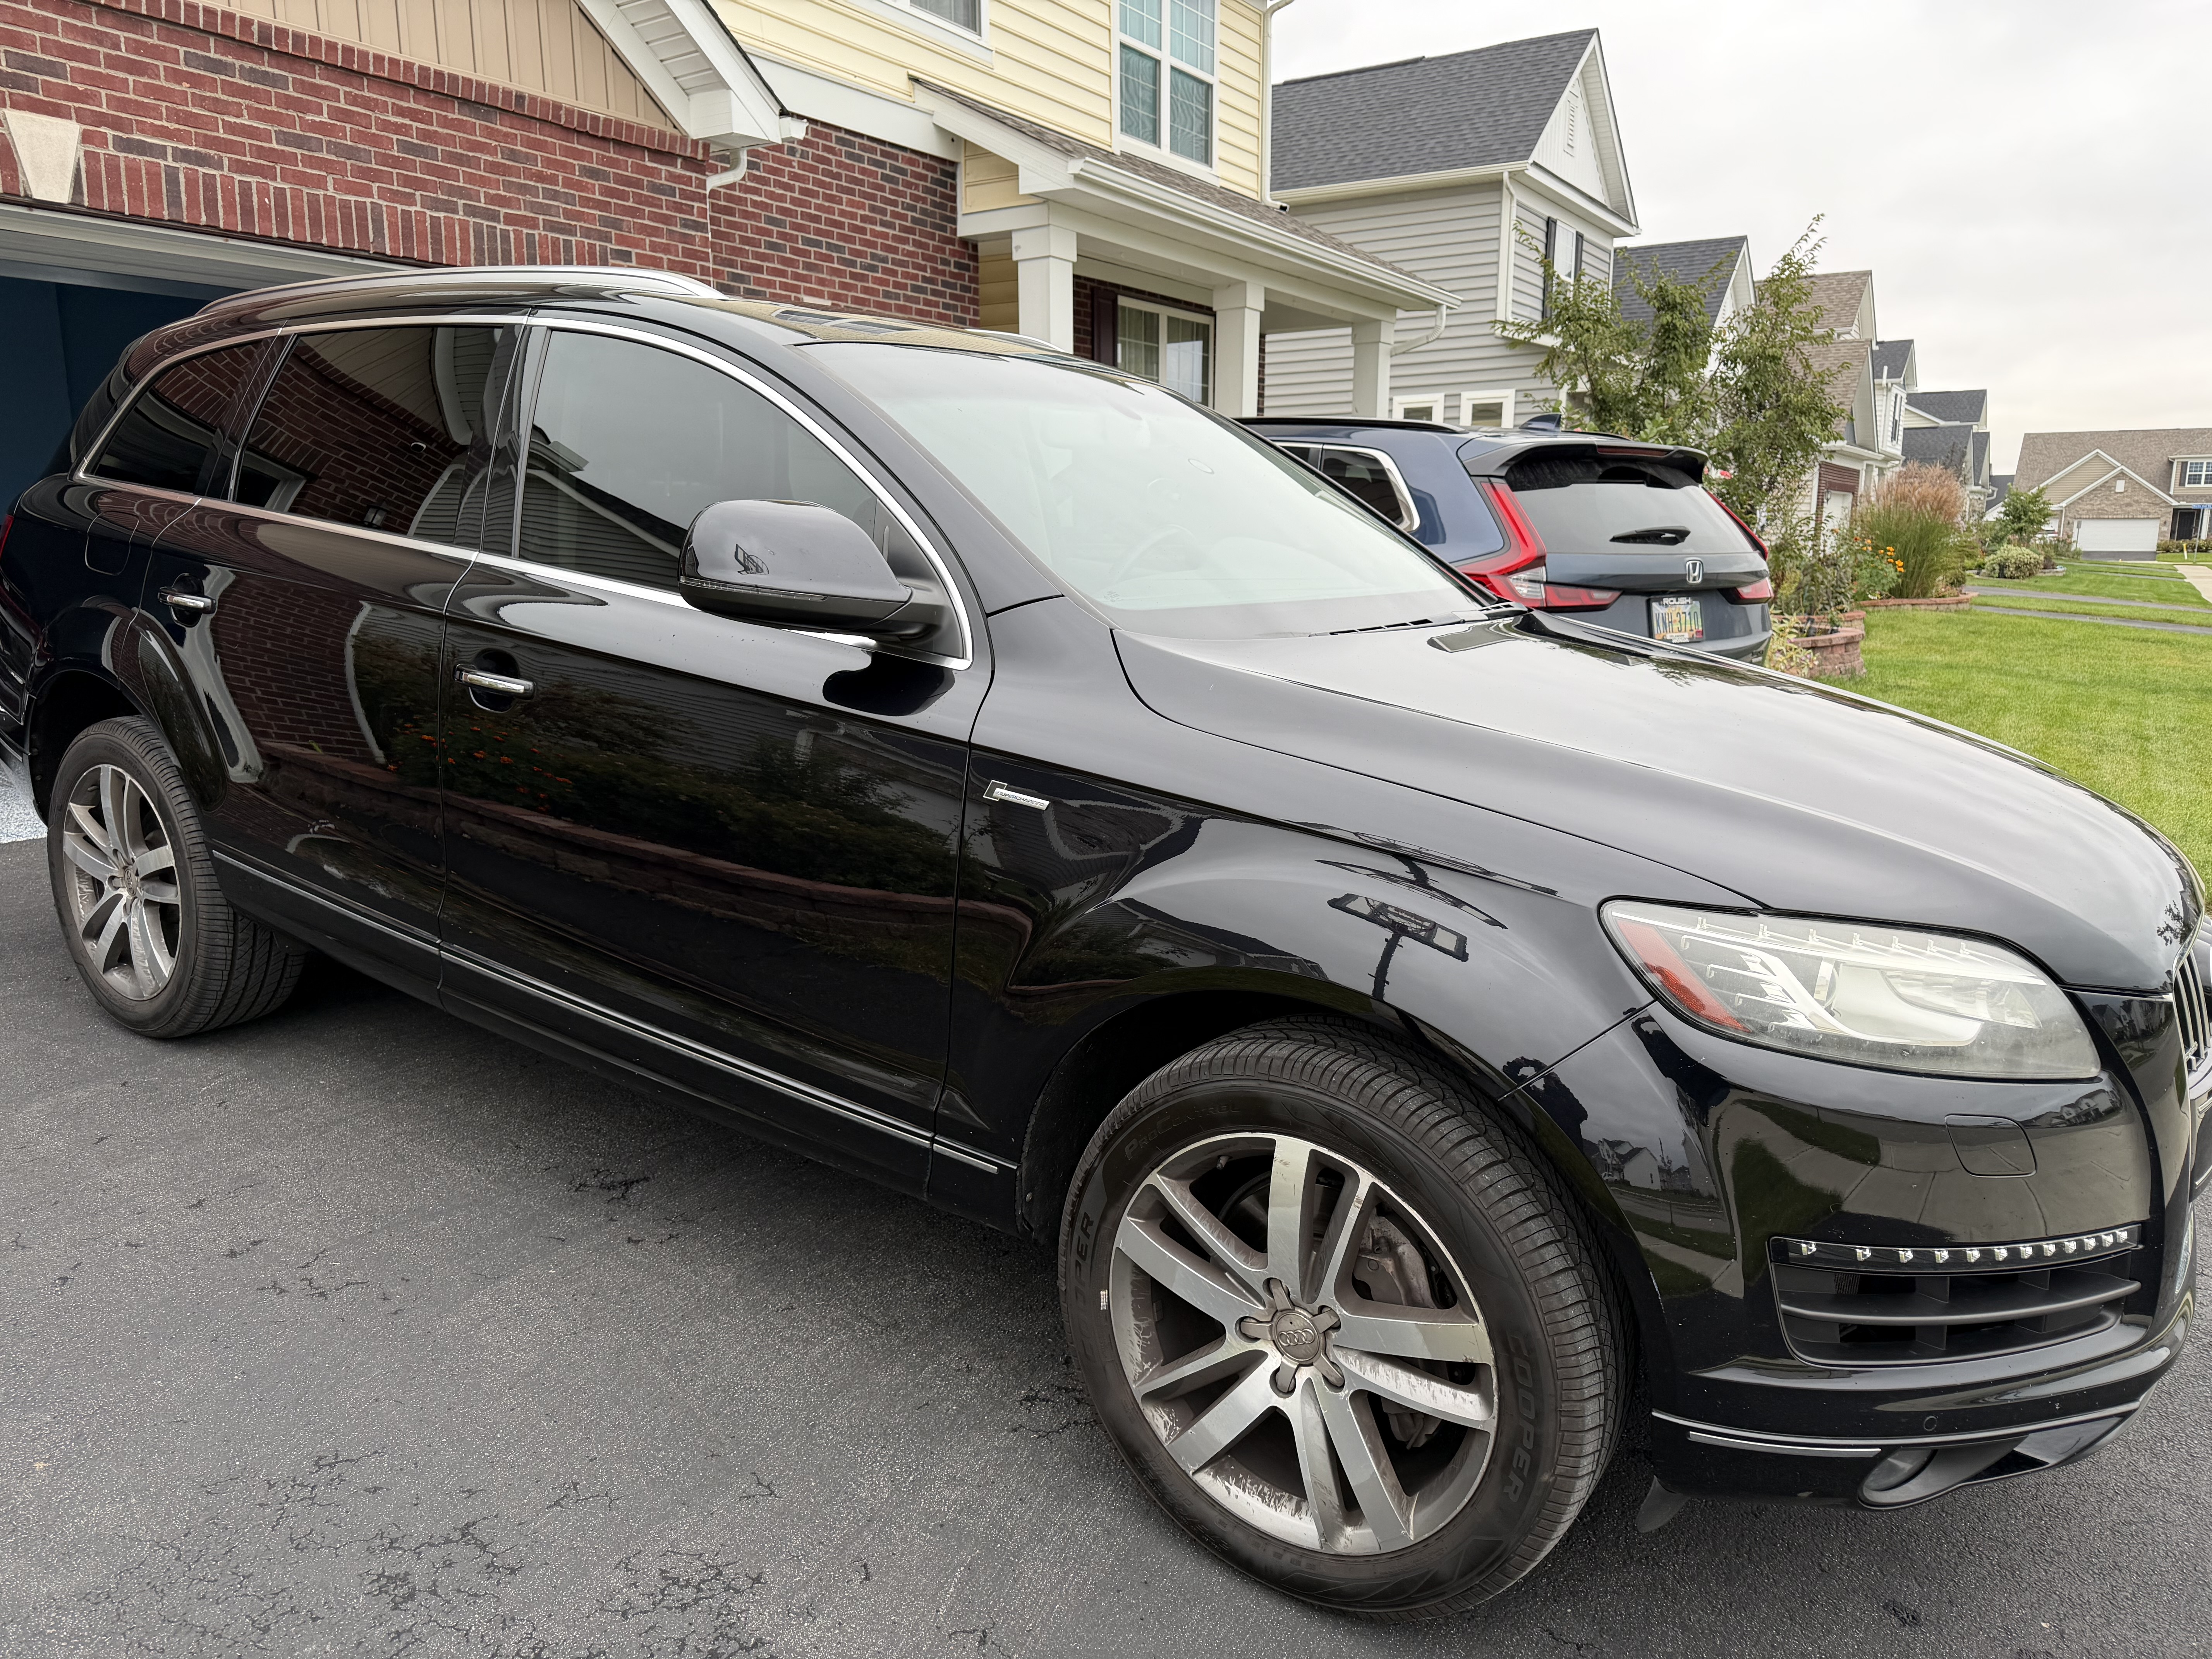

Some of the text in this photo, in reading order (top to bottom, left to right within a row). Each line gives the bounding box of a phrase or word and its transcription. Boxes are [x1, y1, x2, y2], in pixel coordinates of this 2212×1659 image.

[1656, 611, 1699, 634] KNH 3710
[997, 792, 1044, 806] SUPERCHARGED
[1505, 1331, 1535, 1502] COOPER
